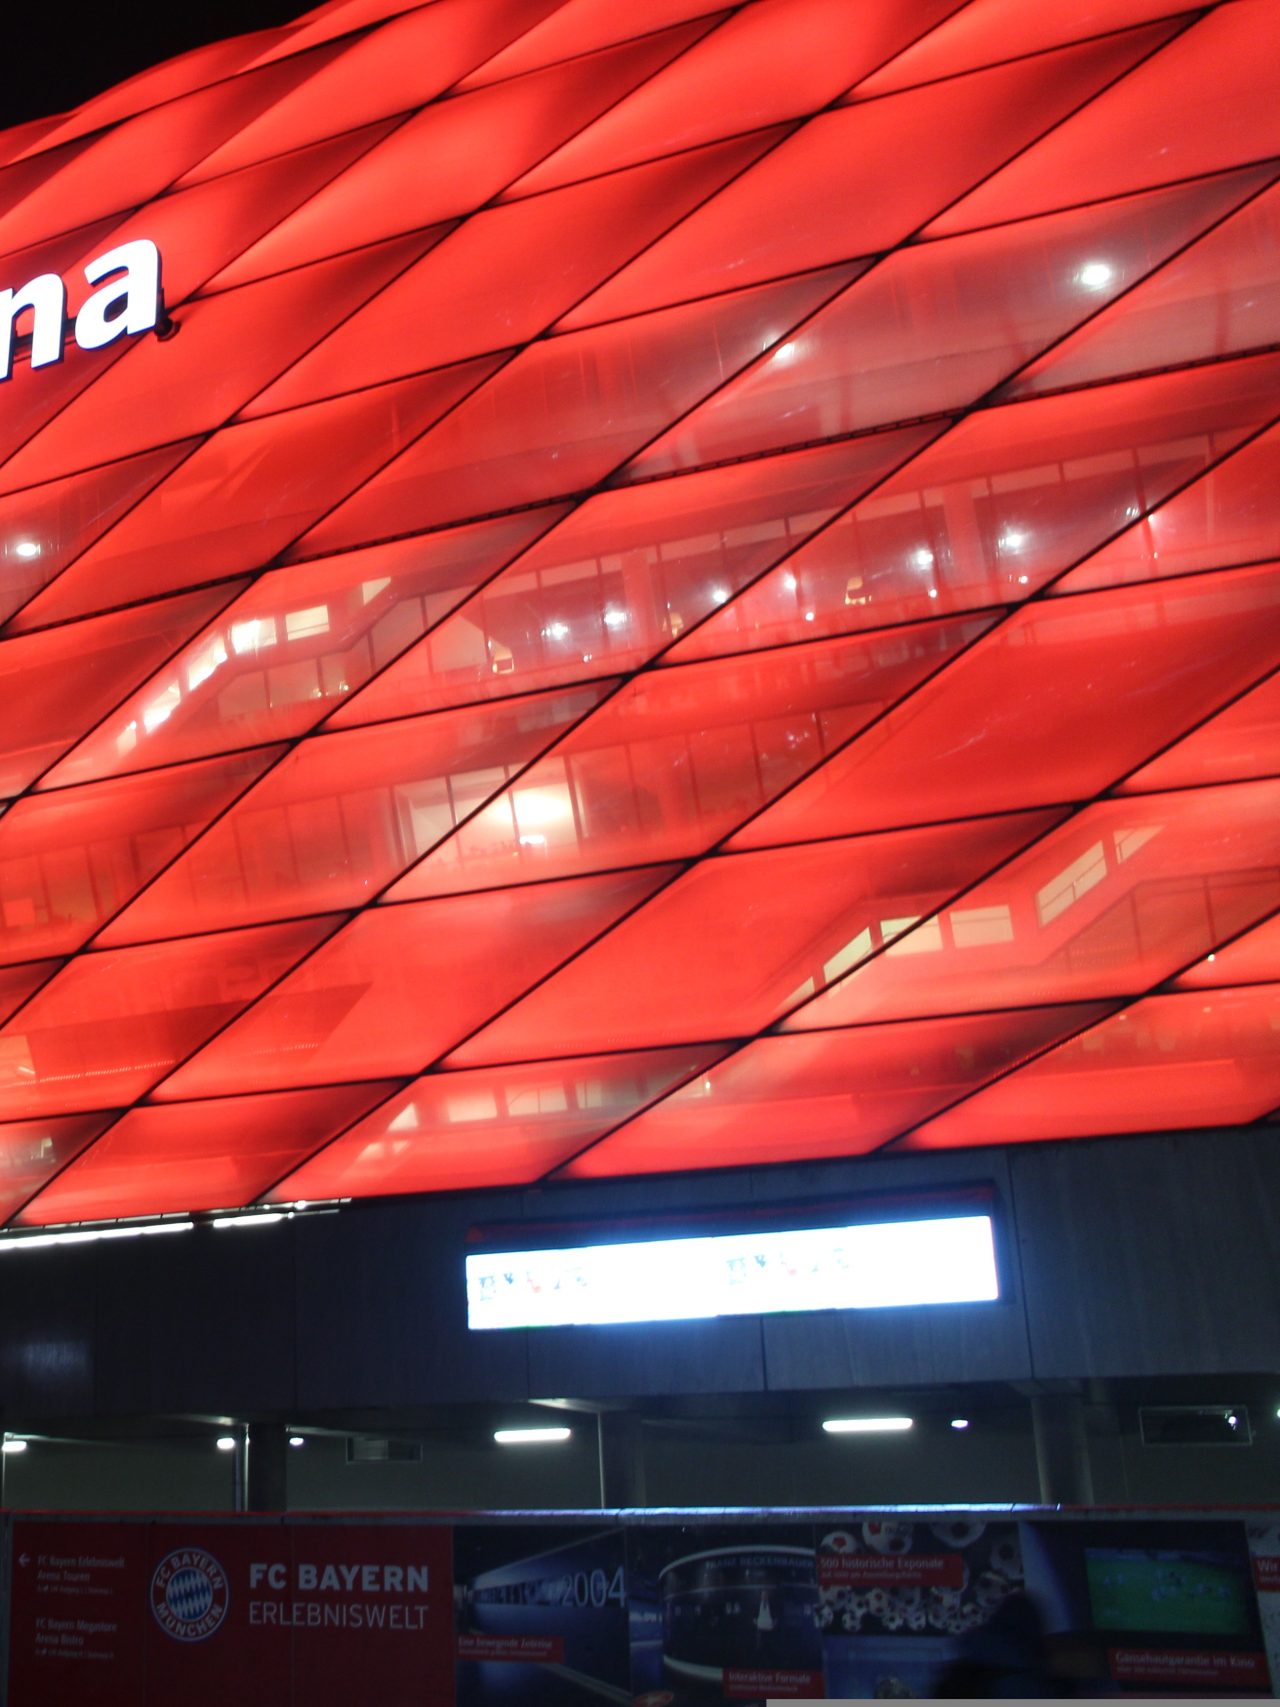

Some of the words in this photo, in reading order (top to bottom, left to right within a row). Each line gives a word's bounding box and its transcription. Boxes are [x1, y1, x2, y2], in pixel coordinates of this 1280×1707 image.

[171, 1553, 224, 1589] BAYERN
[842, 1556, 894, 1569] historische
[249, 1563, 287, 1590] FC
[299, 1564, 429, 1592] BAYERN
[561, 1565, 626, 1609] 2004
[249, 1601, 429, 1630] ERLEBNISWELT
